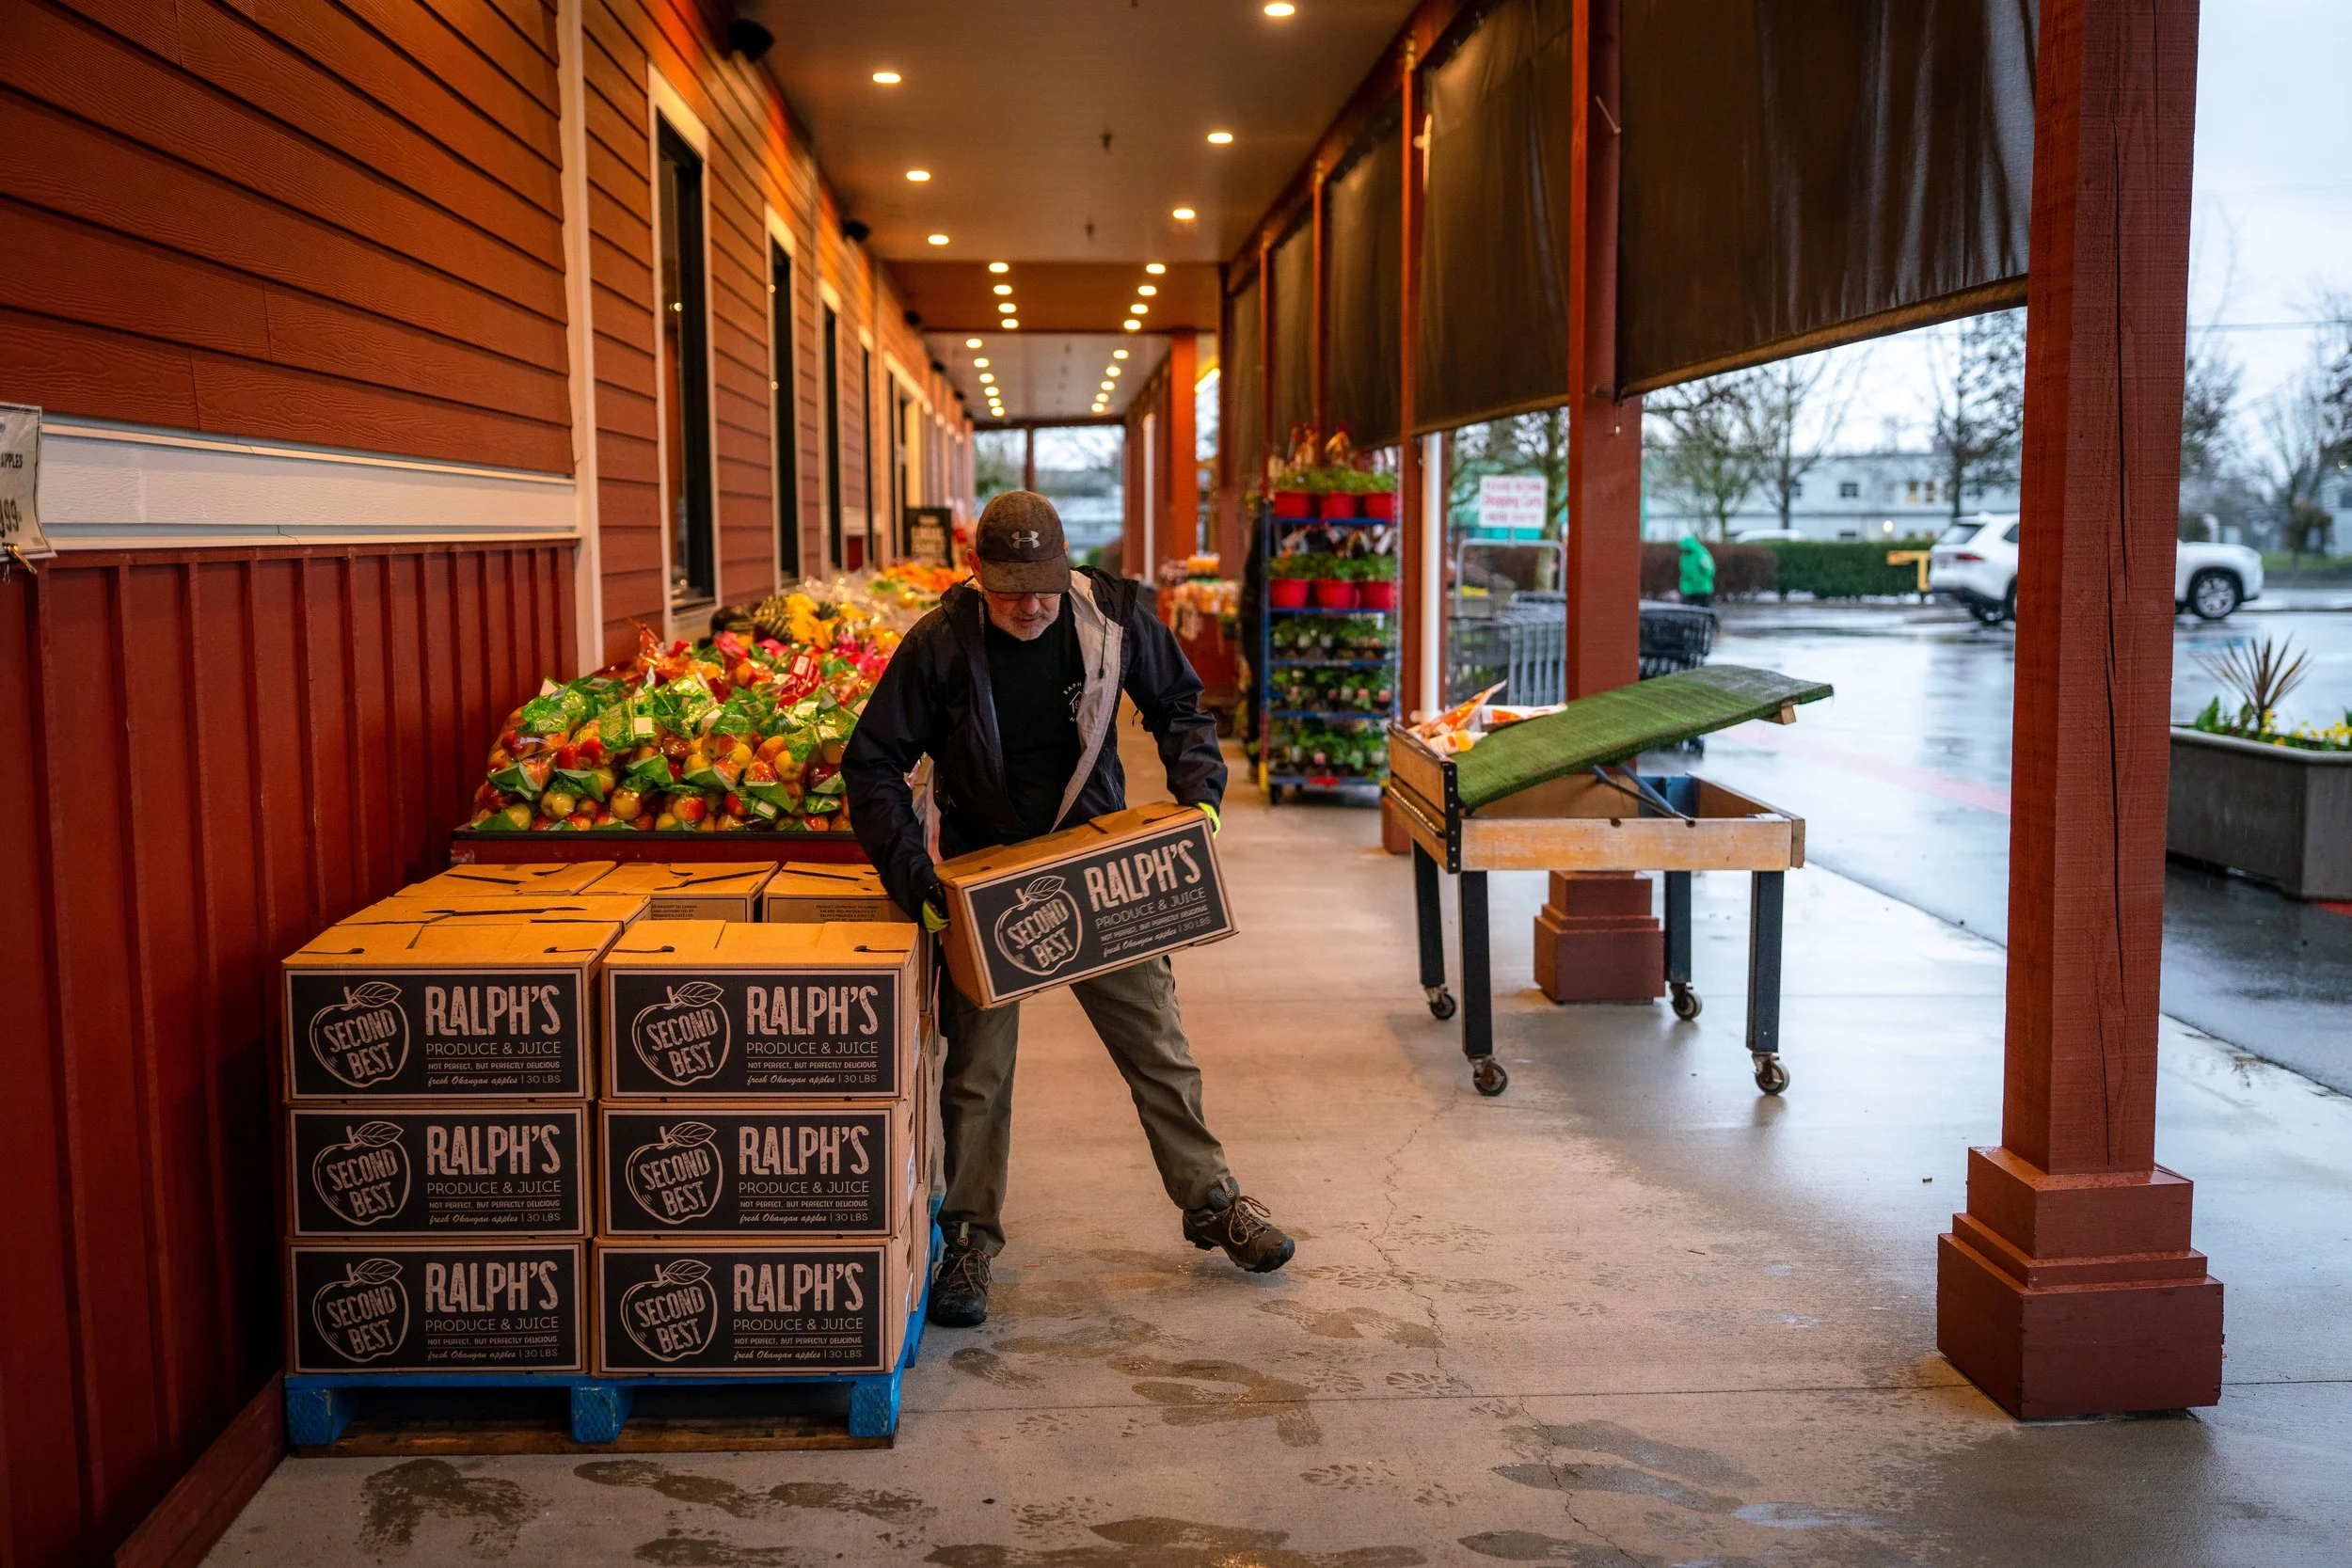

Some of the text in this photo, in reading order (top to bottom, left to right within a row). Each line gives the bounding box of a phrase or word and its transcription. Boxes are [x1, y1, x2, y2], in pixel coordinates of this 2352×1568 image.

[1084, 839, 1200, 912] RALPH'S
[1007, 898, 1069, 950] SECOND
[1095, 886, 1206, 929] PRODUCE & JUICE
[1031, 927, 1073, 968] BEST
[425, 985, 561, 1036] RALPH'S
[747, 986, 878, 1035] RALPH'S
[324, 1009, 397, 1053] SECOND
[426, 1041, 561, 1054] PRODUCE & JUICE
[646, 1008, 718, 1051] SECOND
[747, 1041, 878, 1053] PRODUCE & JUICE
[347, 1042, 394, 1079] BEST
[669, 1041, 714, 1077] BEST
[427, 1076, 449, 1087] fresh
[491, 1076, 517, 1085] apples
[527, 1075, 540, 1084] 30
[542, 1075, 561, 1084] LBS
[747, 1075, 768, 1085] fresh
[809, 1075, 834, 1085] apples
[426, 1124, 560, 1175] RALPH'S
[739, 1126, 869, 1175] RALPH'S
[326, 1148, 398, 1192] SECOND
[428, 1180, 561, 1194] PRODUCE & JUICE
[639, 1148, 710, 1190] SECOND
[739, 1180, 869, 1193] PRODUCE & JUICE
[349, 1181, 395, 1217] BEST
[662, 1180, 707, 1216] BEST
[429, 1214, 450, 1226] fresh
[491, 1214, 517, 1224] apples
[542, 1213, 560, 1222] LBS
[739, 1213, 760, 1225] fresh
[801, 1213, 826, 1223] apples
[425, 1260, 558, 1312] RALPH'S
[734, 1262, 864, 1312] RALPH'S
[325, 1286, 397, 1329] SECOND
[426, 1316, 558, 1331] PRODUCE & JUICE
[634, 1286, 706, 1328] SECOND
[734, 1317, 863, 1330] PRODUCE & JUICE
[348, 1319, 394, 1354] BEST
[657, 1318, 702, 1354] BEST
[427, 1352, 448, 1362] fresh
[489, 1351, 515, 1360] apples
[524, 1350, 536, 1358] 30
[539, 1350, 557, 1358] LBS
[734, 1351, 755, 1361] fresh
[795, 1351, 820, 1360] apples
[829, 1350, 841, 1358] 30
[844, 1350, 862, 1358] LBS
